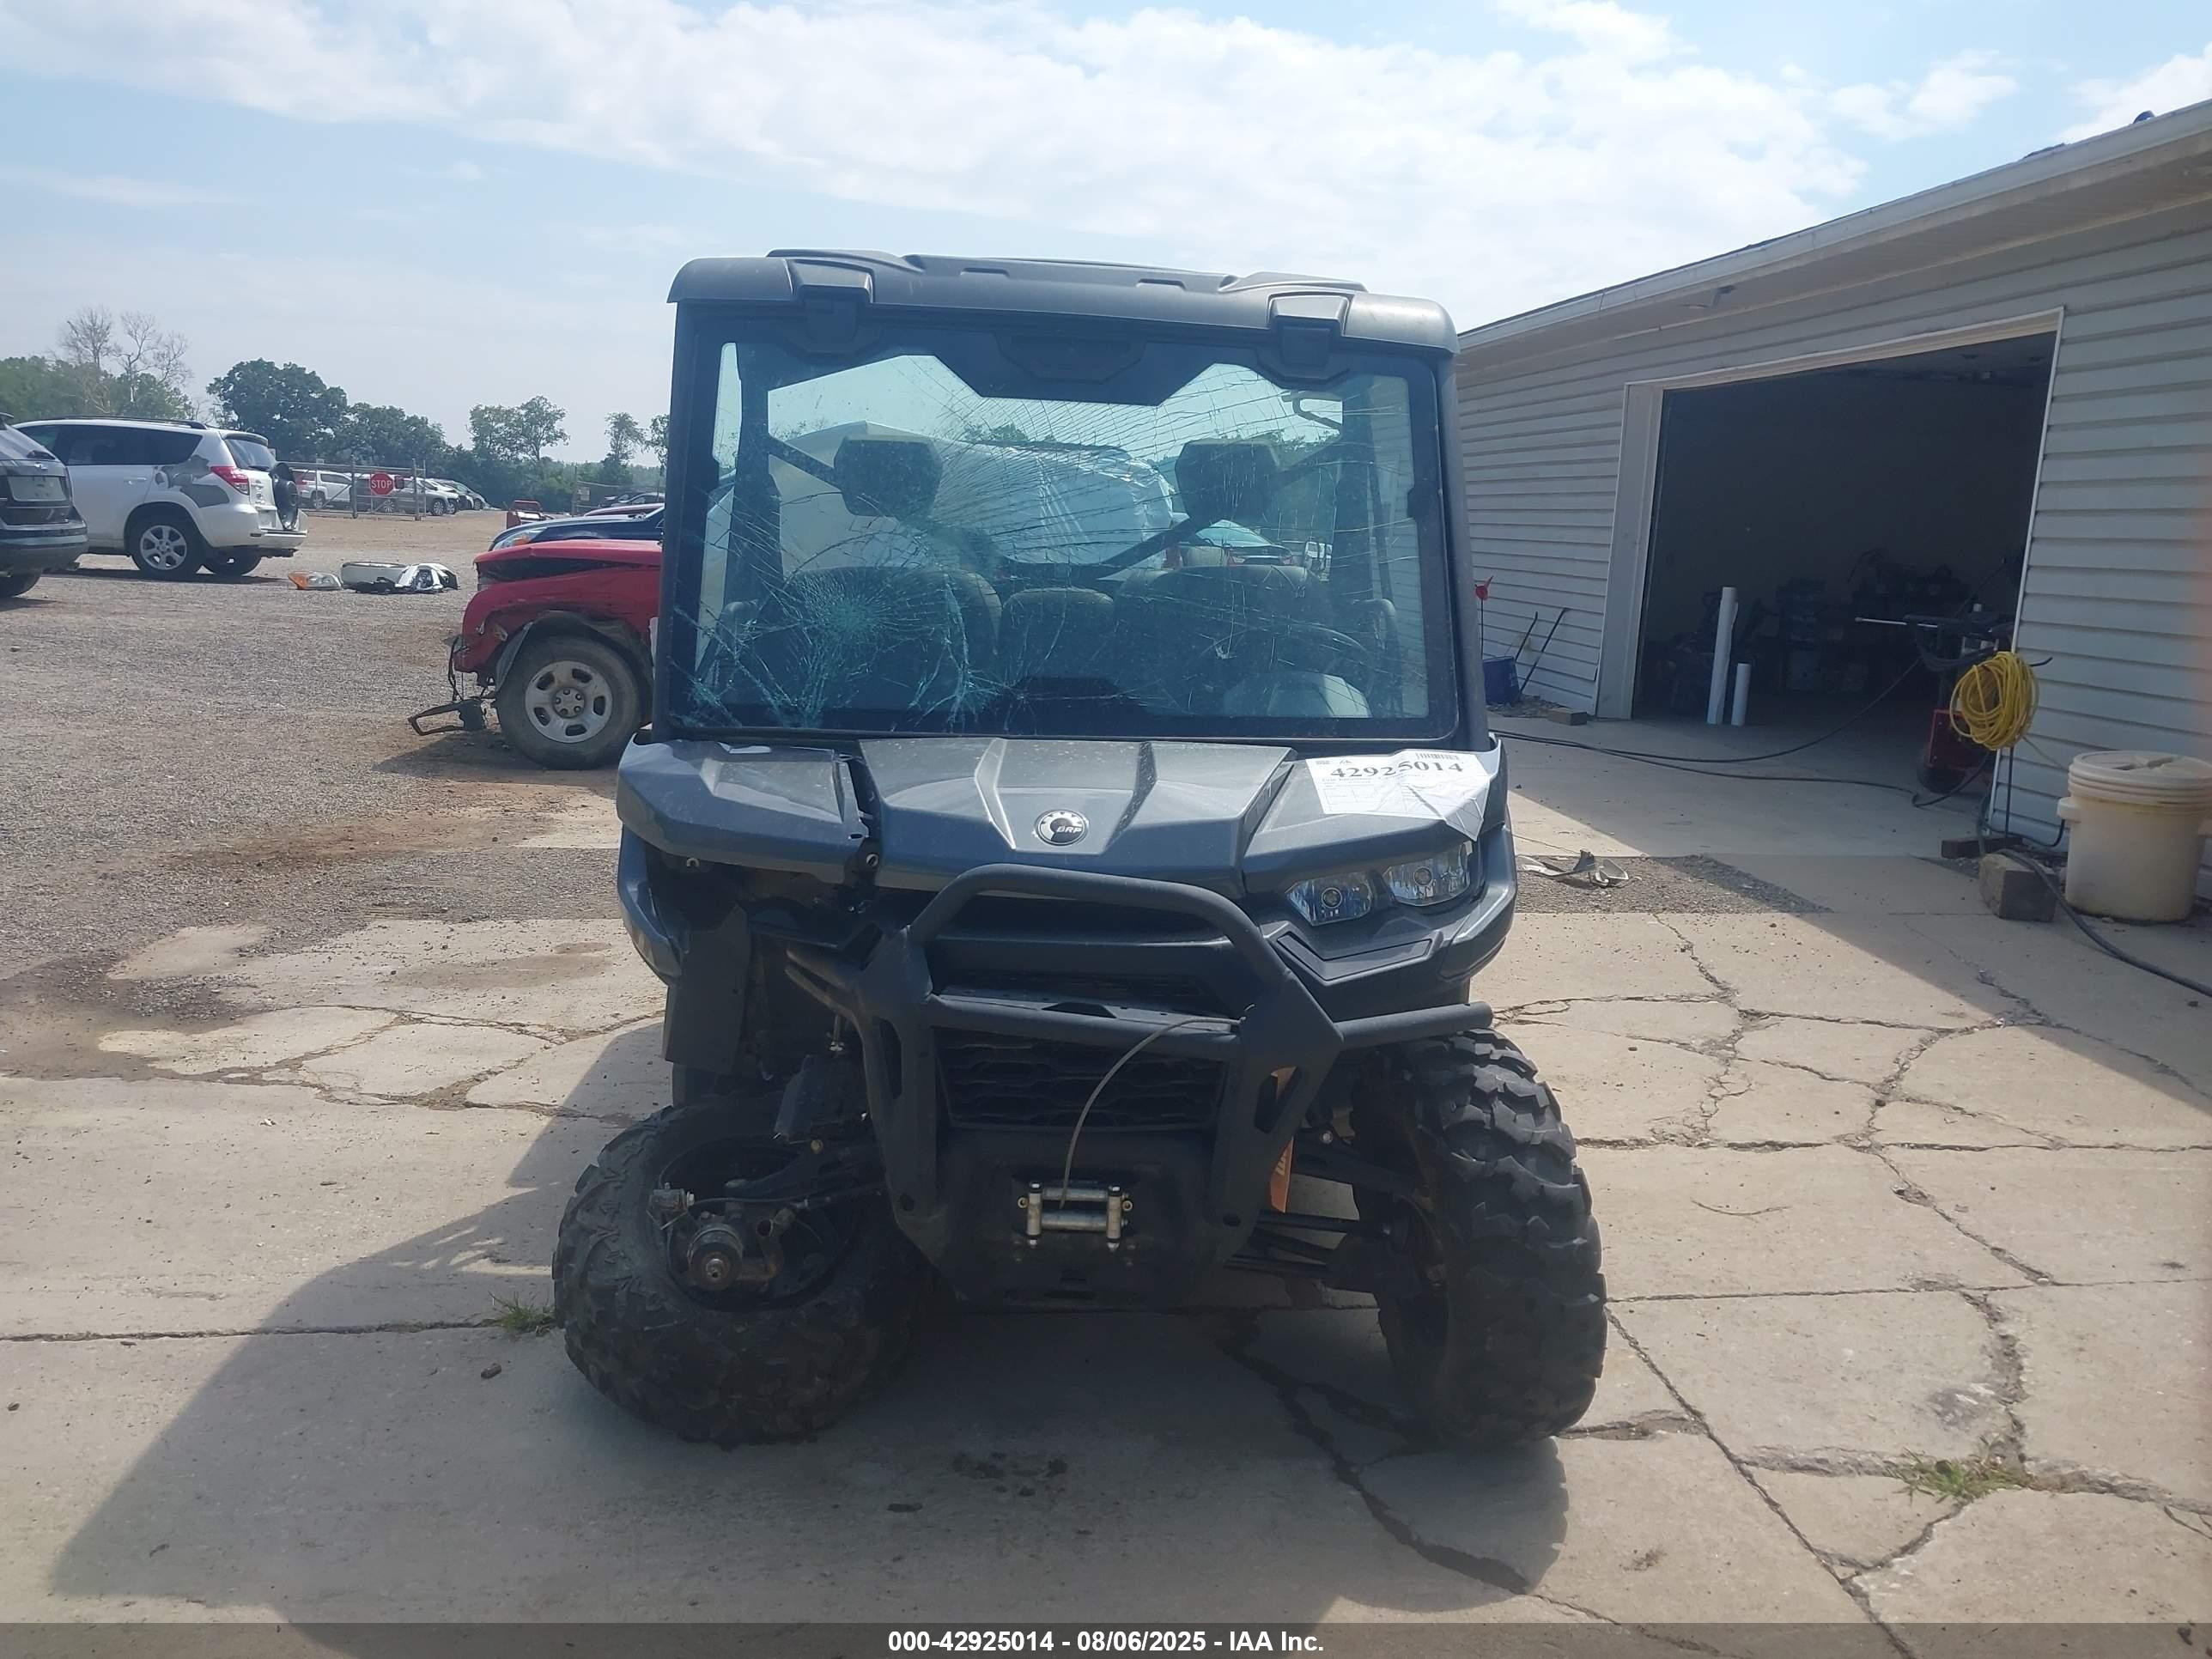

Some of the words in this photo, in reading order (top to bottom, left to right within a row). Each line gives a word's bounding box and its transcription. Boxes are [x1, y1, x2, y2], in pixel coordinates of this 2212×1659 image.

[371, 479, 392, 489] STOP
[1330, 761, 1464, 778] 42925014
[1056, 825, 1082, 834] BRP
